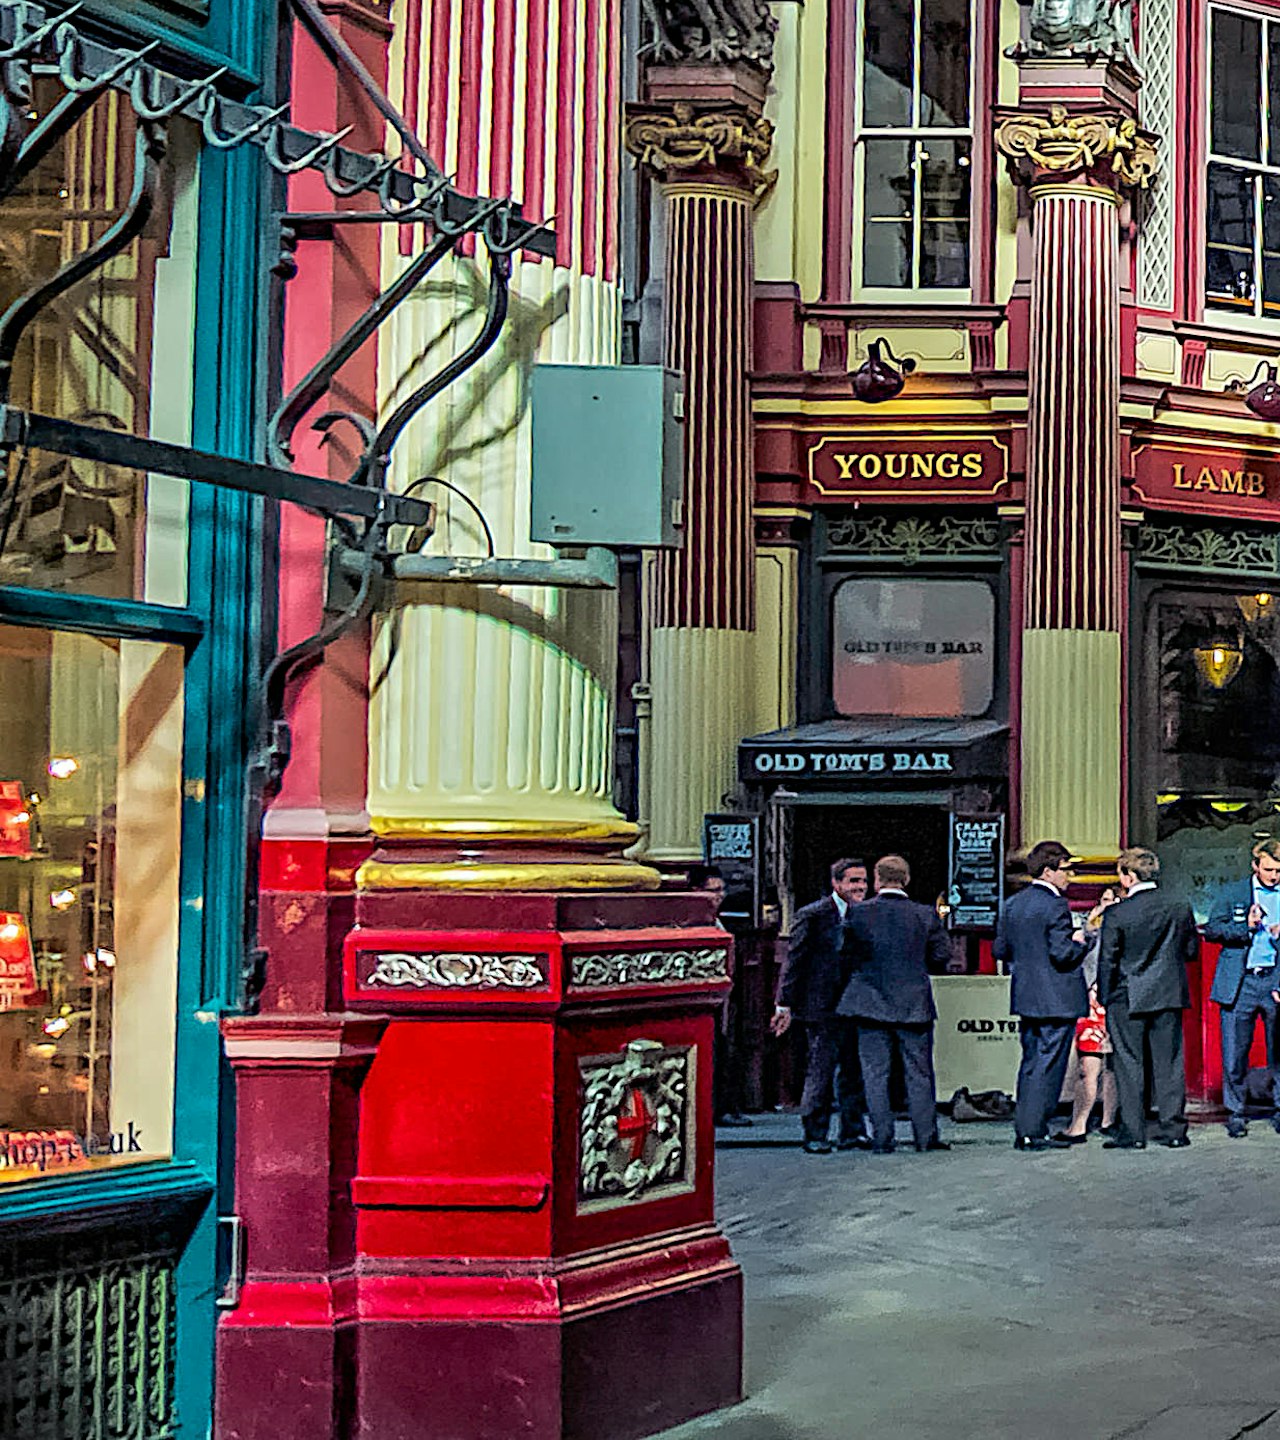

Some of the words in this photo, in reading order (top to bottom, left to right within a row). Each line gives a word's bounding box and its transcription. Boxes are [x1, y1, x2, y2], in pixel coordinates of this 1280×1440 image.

[833, 453, 984, 479] YOUNGS
[1173, 464, 1265, 496] LAMB
[755, 753, 805, 772] OLD
[812, 753, 885, 772] TOM'S
[892, 753, 953, 771] BAR
[957, 1019, 995, 1033] OLD
[997, 1019, 1019, 1033] TO
